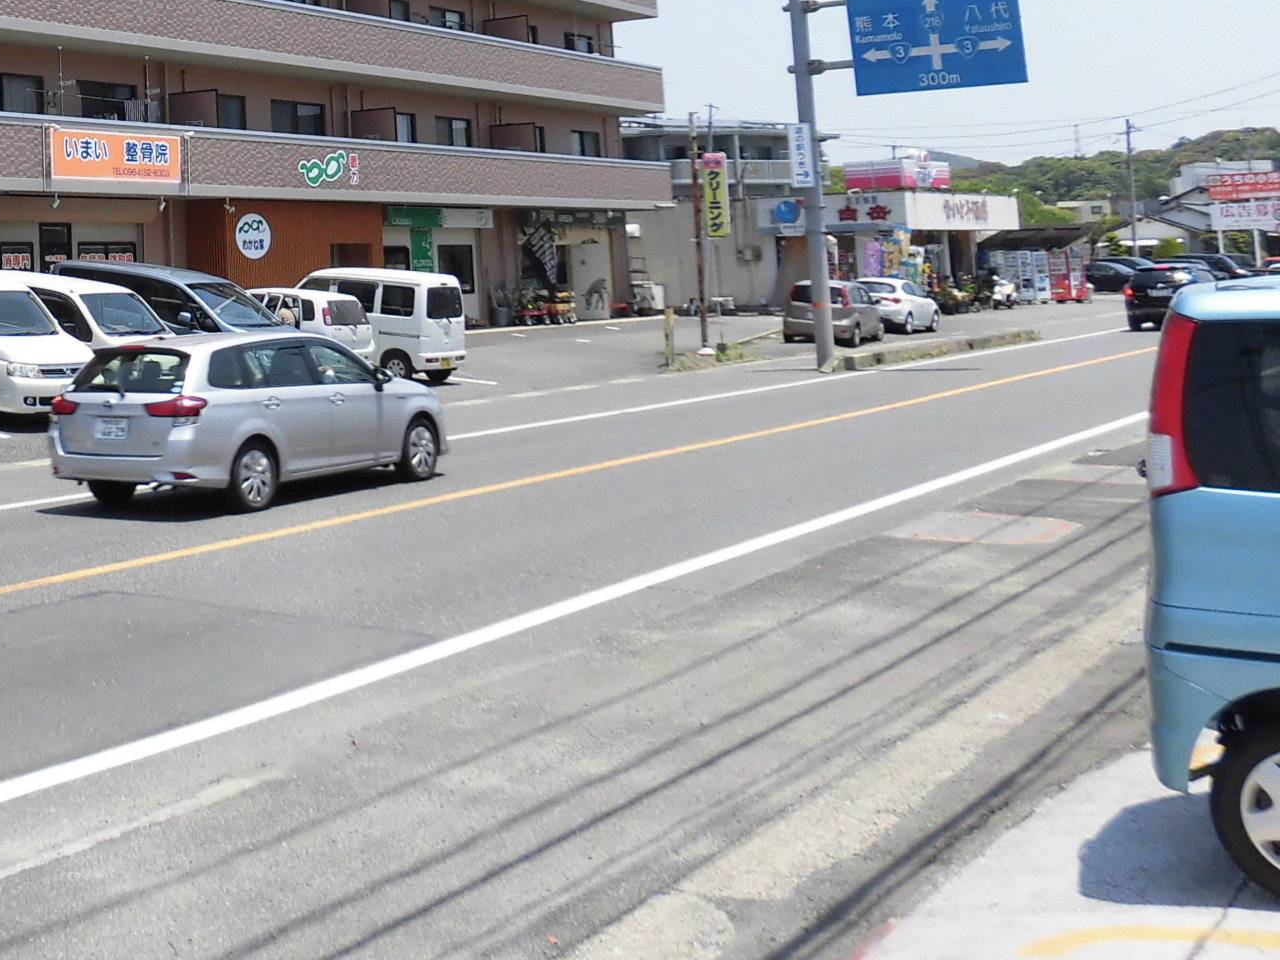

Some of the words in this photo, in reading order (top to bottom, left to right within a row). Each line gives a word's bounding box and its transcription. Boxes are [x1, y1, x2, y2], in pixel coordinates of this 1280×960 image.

[964, 1, 1010, 21] 八代
[854, 13, 900, 32] 熊本
[895, 46, 905, 58] 3
[964, 40, 973, 53] 3
[919, 72, 960, 87] 300m
[64, 137, 109, 160] いまい
[124, 140, 169, 164] 整骨院
[708, 170, 724, 232] クリーニング
